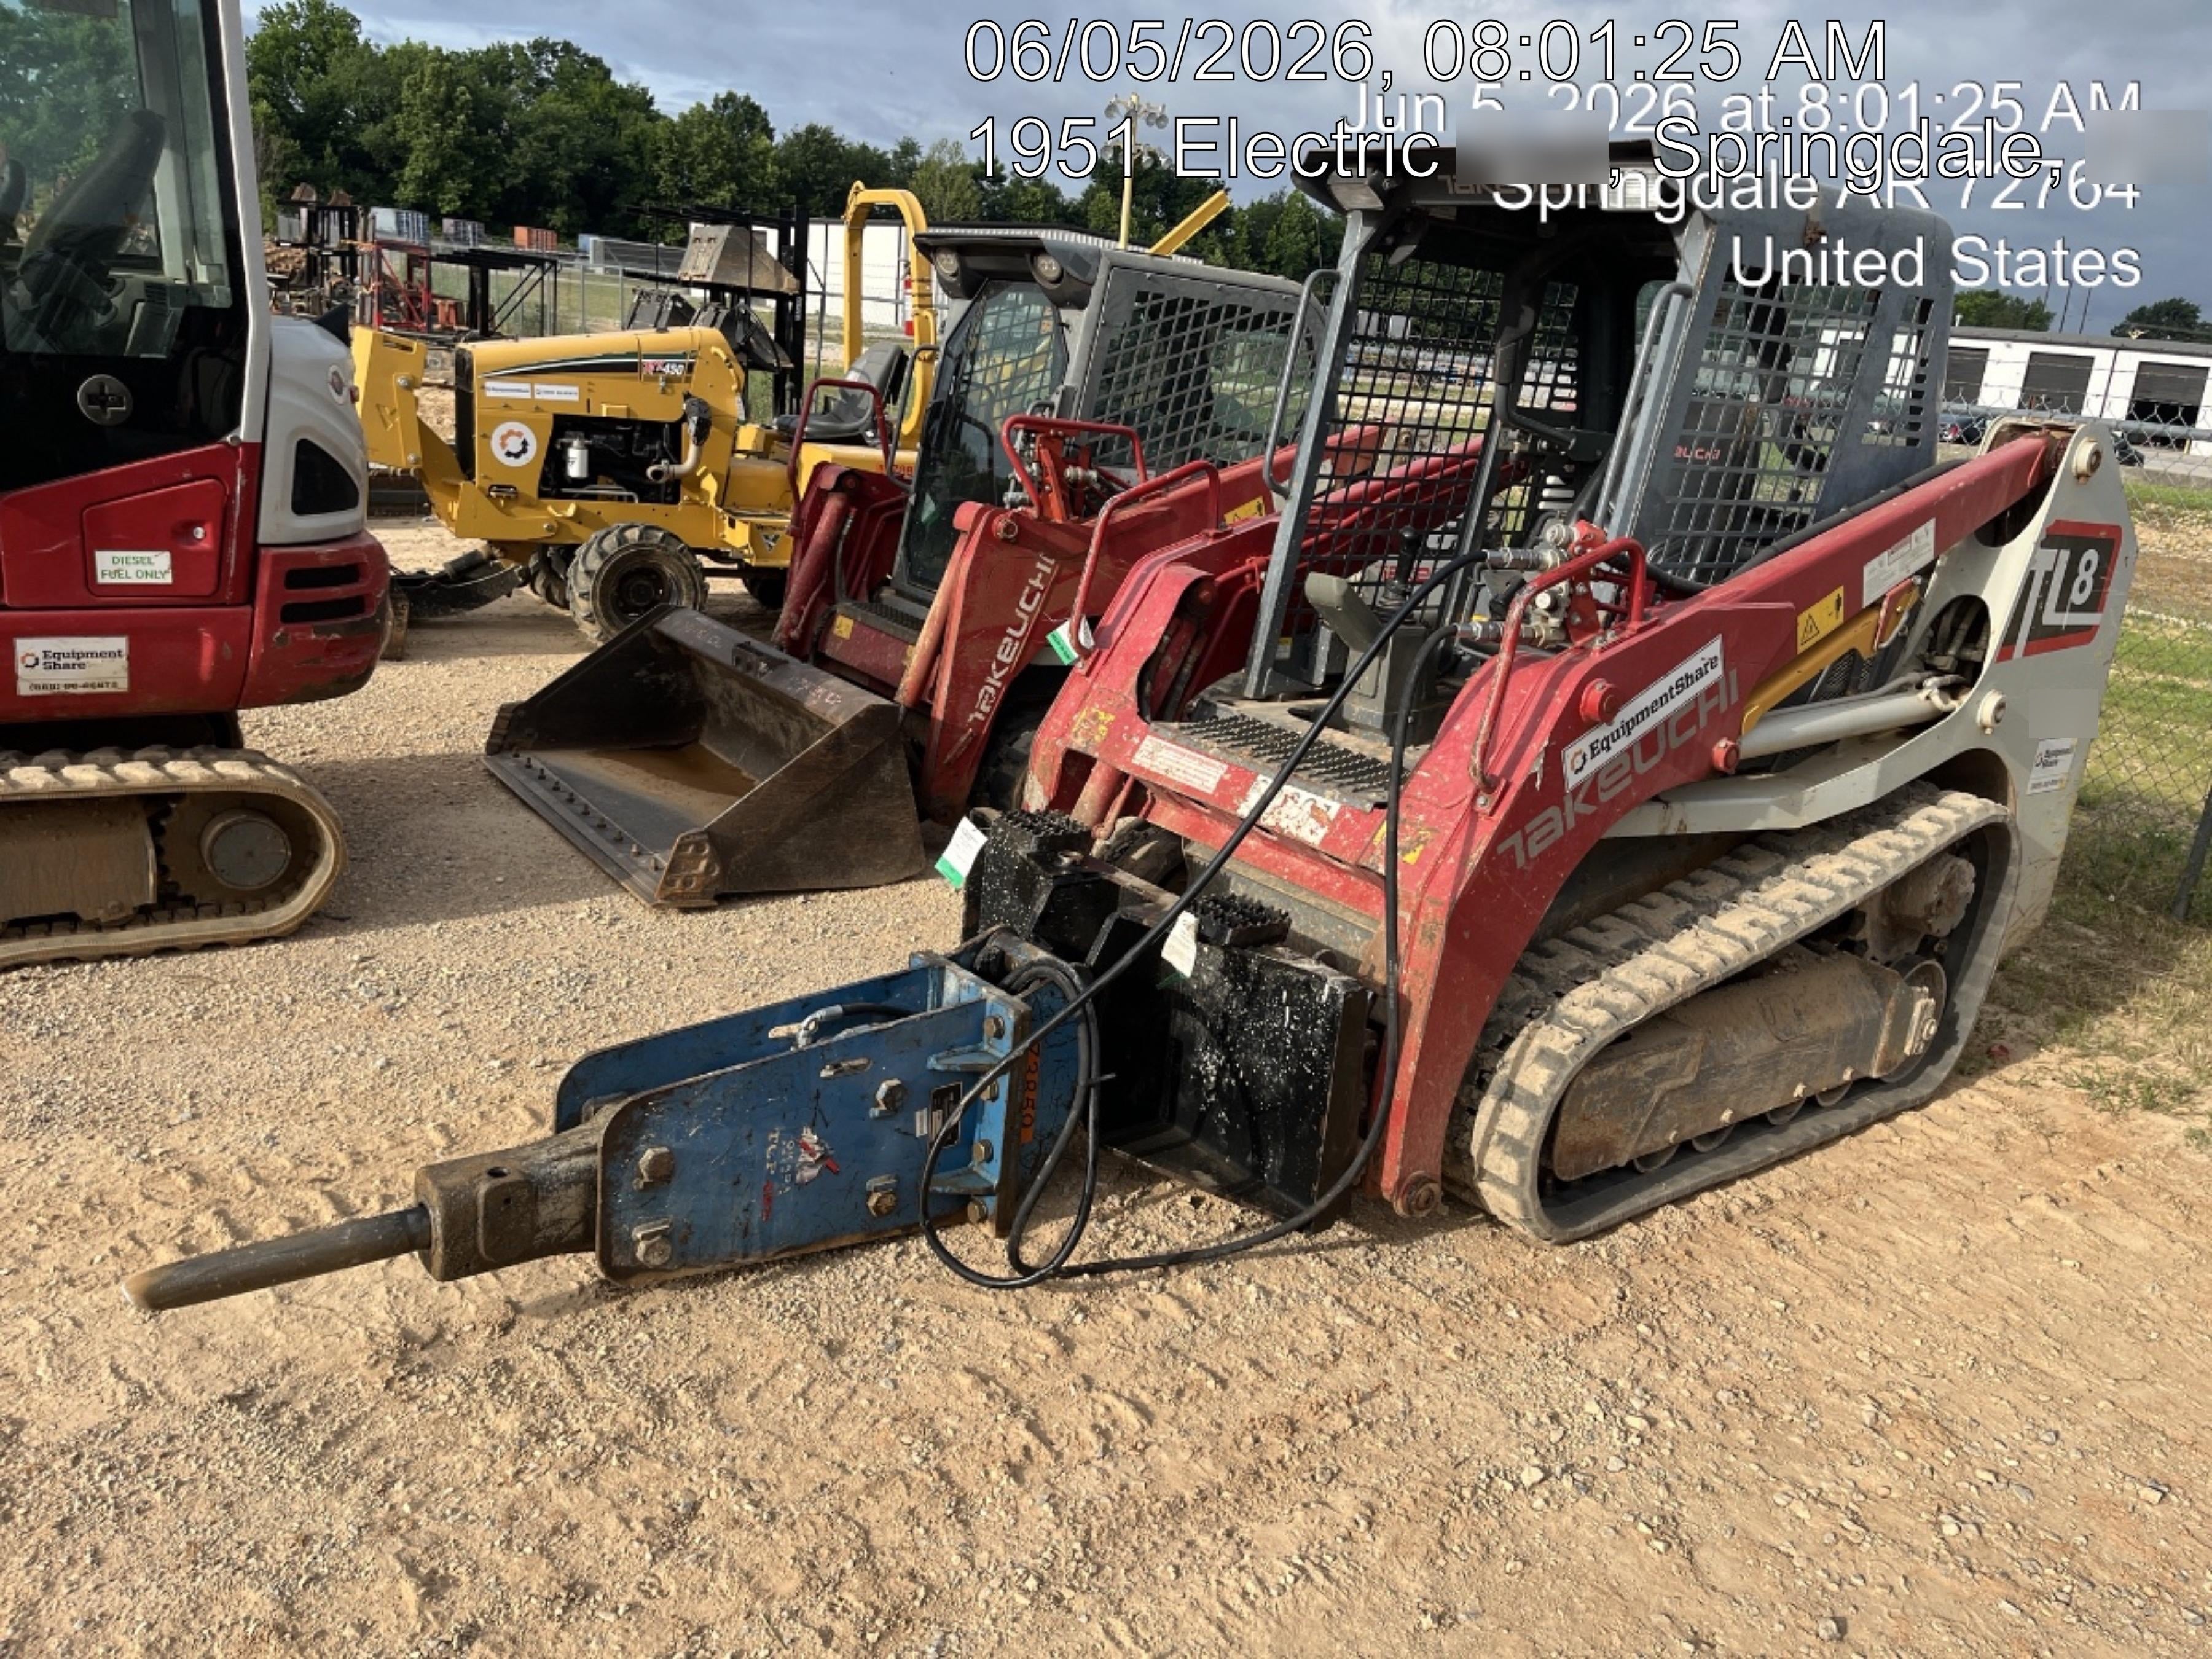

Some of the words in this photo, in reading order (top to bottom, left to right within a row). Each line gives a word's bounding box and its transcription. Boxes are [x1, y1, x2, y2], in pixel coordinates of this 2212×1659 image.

[112, 556, 155, 565] DIESEL
[101, 569, 132, 579] FUEL
[136, 569, 169, 579] ONLY
[42, 648, 123, 661] Equipment
[42, 661, 87, 670] Share
[1589, 654, 1719, 760] EquipmentShare
